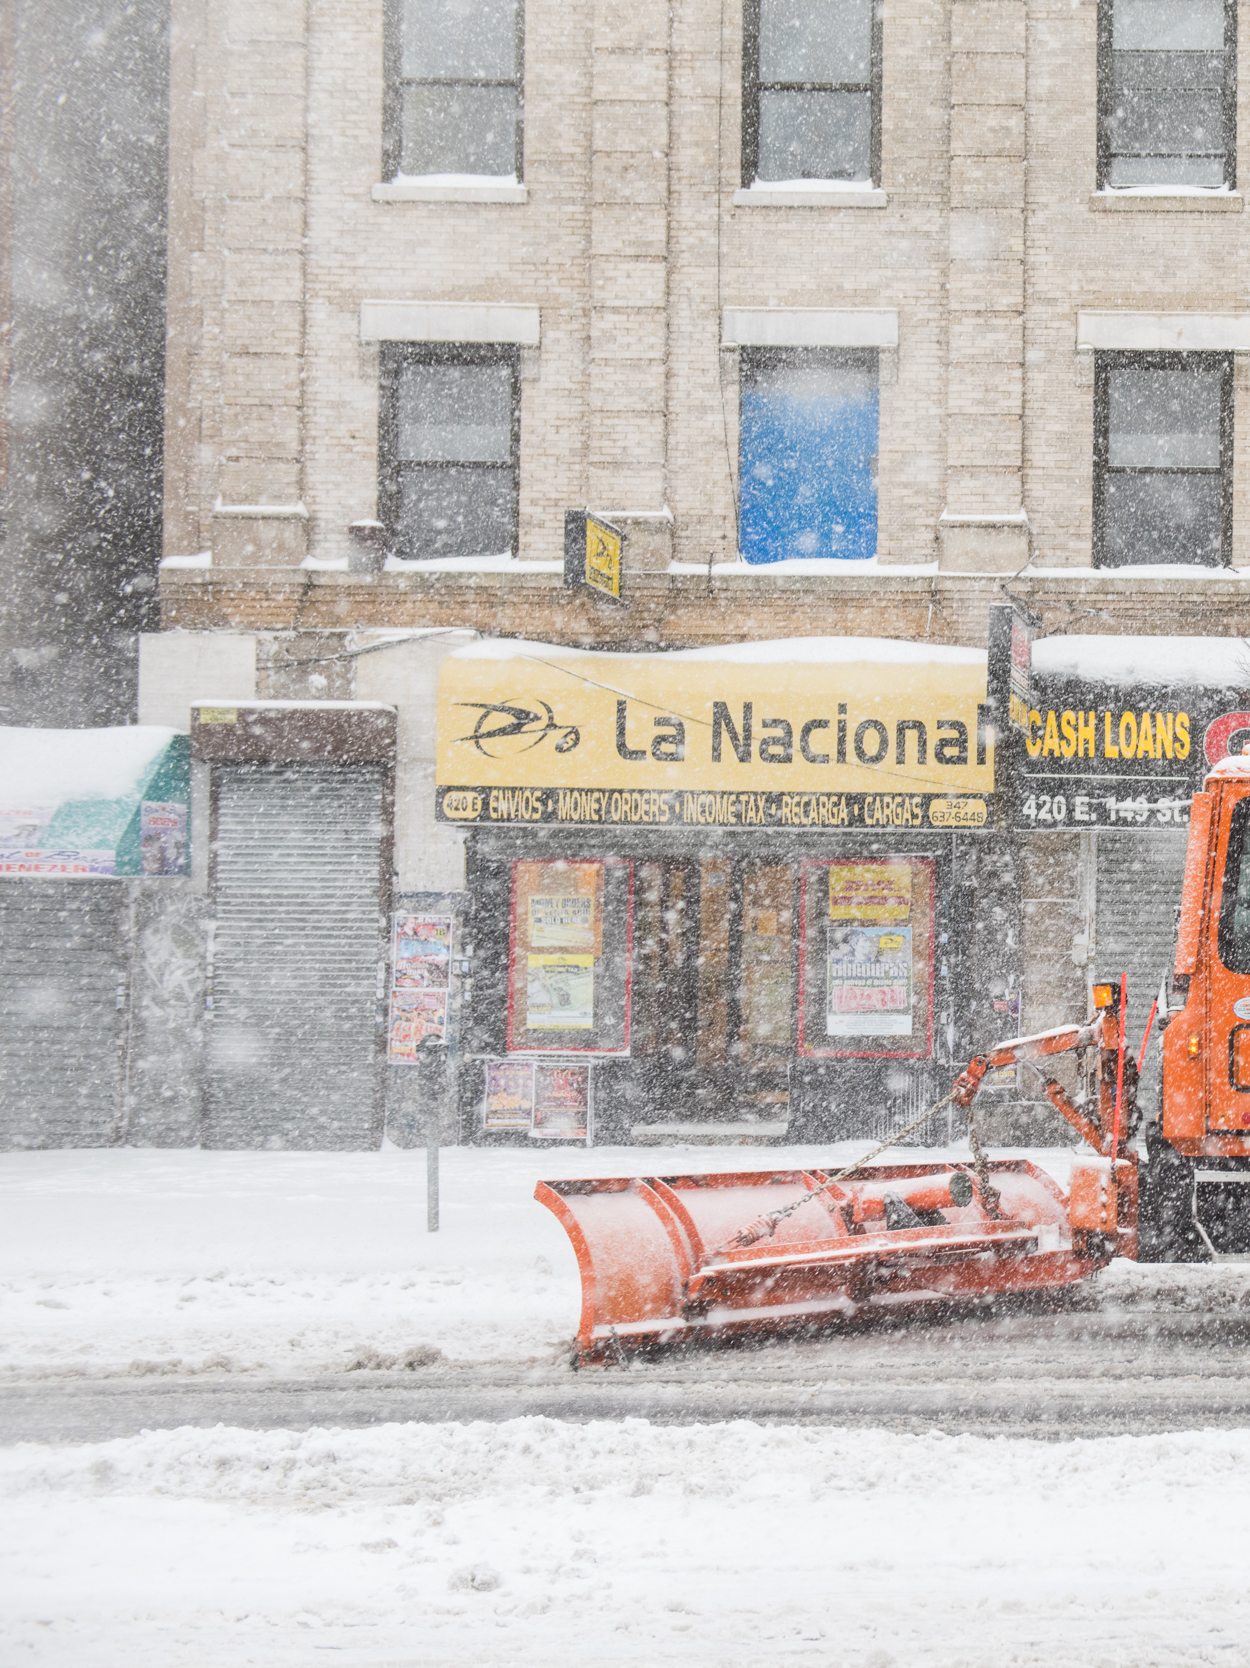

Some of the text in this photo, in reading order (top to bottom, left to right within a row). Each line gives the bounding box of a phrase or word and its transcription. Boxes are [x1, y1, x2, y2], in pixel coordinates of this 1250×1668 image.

[615, 699, 686, 762] La
[711, 700, 988, 766] Nacional
[1025, 709, 1096, 757] CASH
[1104, 710, 1191, 760] LOANS
[471, 796, 479, 812] E
[489, 789, 922, 825] ENVIOS MONEY ORDERS INCOME TAX RECARGA CARGAS
[945, 800, 968, 810] 347
[1022, 795, 1189, 822] 420 E. 149 St.
[931, 811, 984, 823] 637-6448
[0, 863, 88, 873] ENEZER
